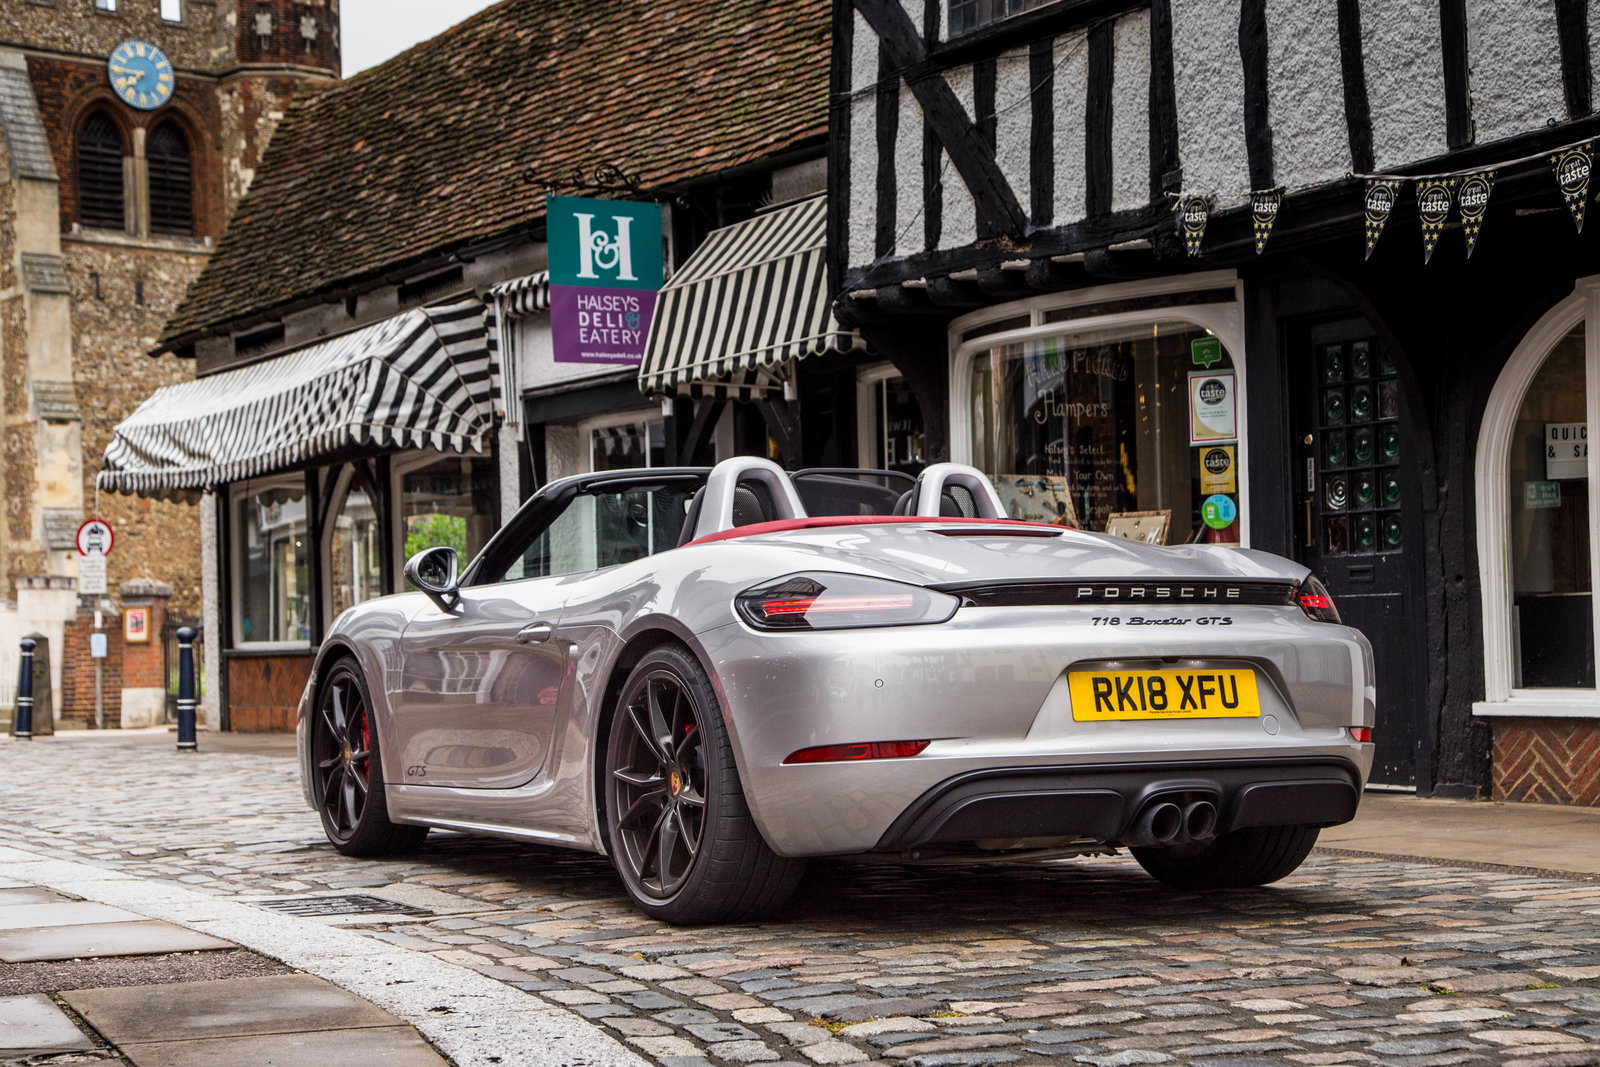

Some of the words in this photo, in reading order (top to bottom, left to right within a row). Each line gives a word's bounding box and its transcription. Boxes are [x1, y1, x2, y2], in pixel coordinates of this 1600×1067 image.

[1564, 159, 1581, 173] great
[1559, 165, 1590, 185] taste
[1373, 192, 1388, 200] great
[1466, 185, 1482, 195] great
[1427, 192, 1444, 201] great
[1460, 192, 1488, 207] taste
[1254, 202, 1278, 212] taste
[1367, 198, 1391, 211] taste
[1421, 200, 1449, 212] taste
[1185, 211, 1207, 222] taste
[577, 294, 640, 312] HALSEY'S
[578, 312, 623, 328] DELI
[624, 311, 641, 330] &
[579, 328, 642, 345] EATERY
[581, 351, 642, 360] www.halseysdeli.co.uk
[1201, 389, 1225, 398] taste
[1034, 388, 1109, 426] Hampers
[1547, 445, 1556, 458] &
[1205, 458, 1230, 468] taste
[1074, 470, 1091, 481] Your
[1095, 470, 1115, 481] Own
[1077, 587, 1240, 598] PORSCHE
[1091, 616, 1121, 626] 718
[1125, 616, 1192, 626] Boxster
[1195, 616, 1233, 626] GTS
[1091, 676, 1168, 712] RK18
[1176, 675, 1239, 710] XFU
[407, 765, 427, 777] GTS
